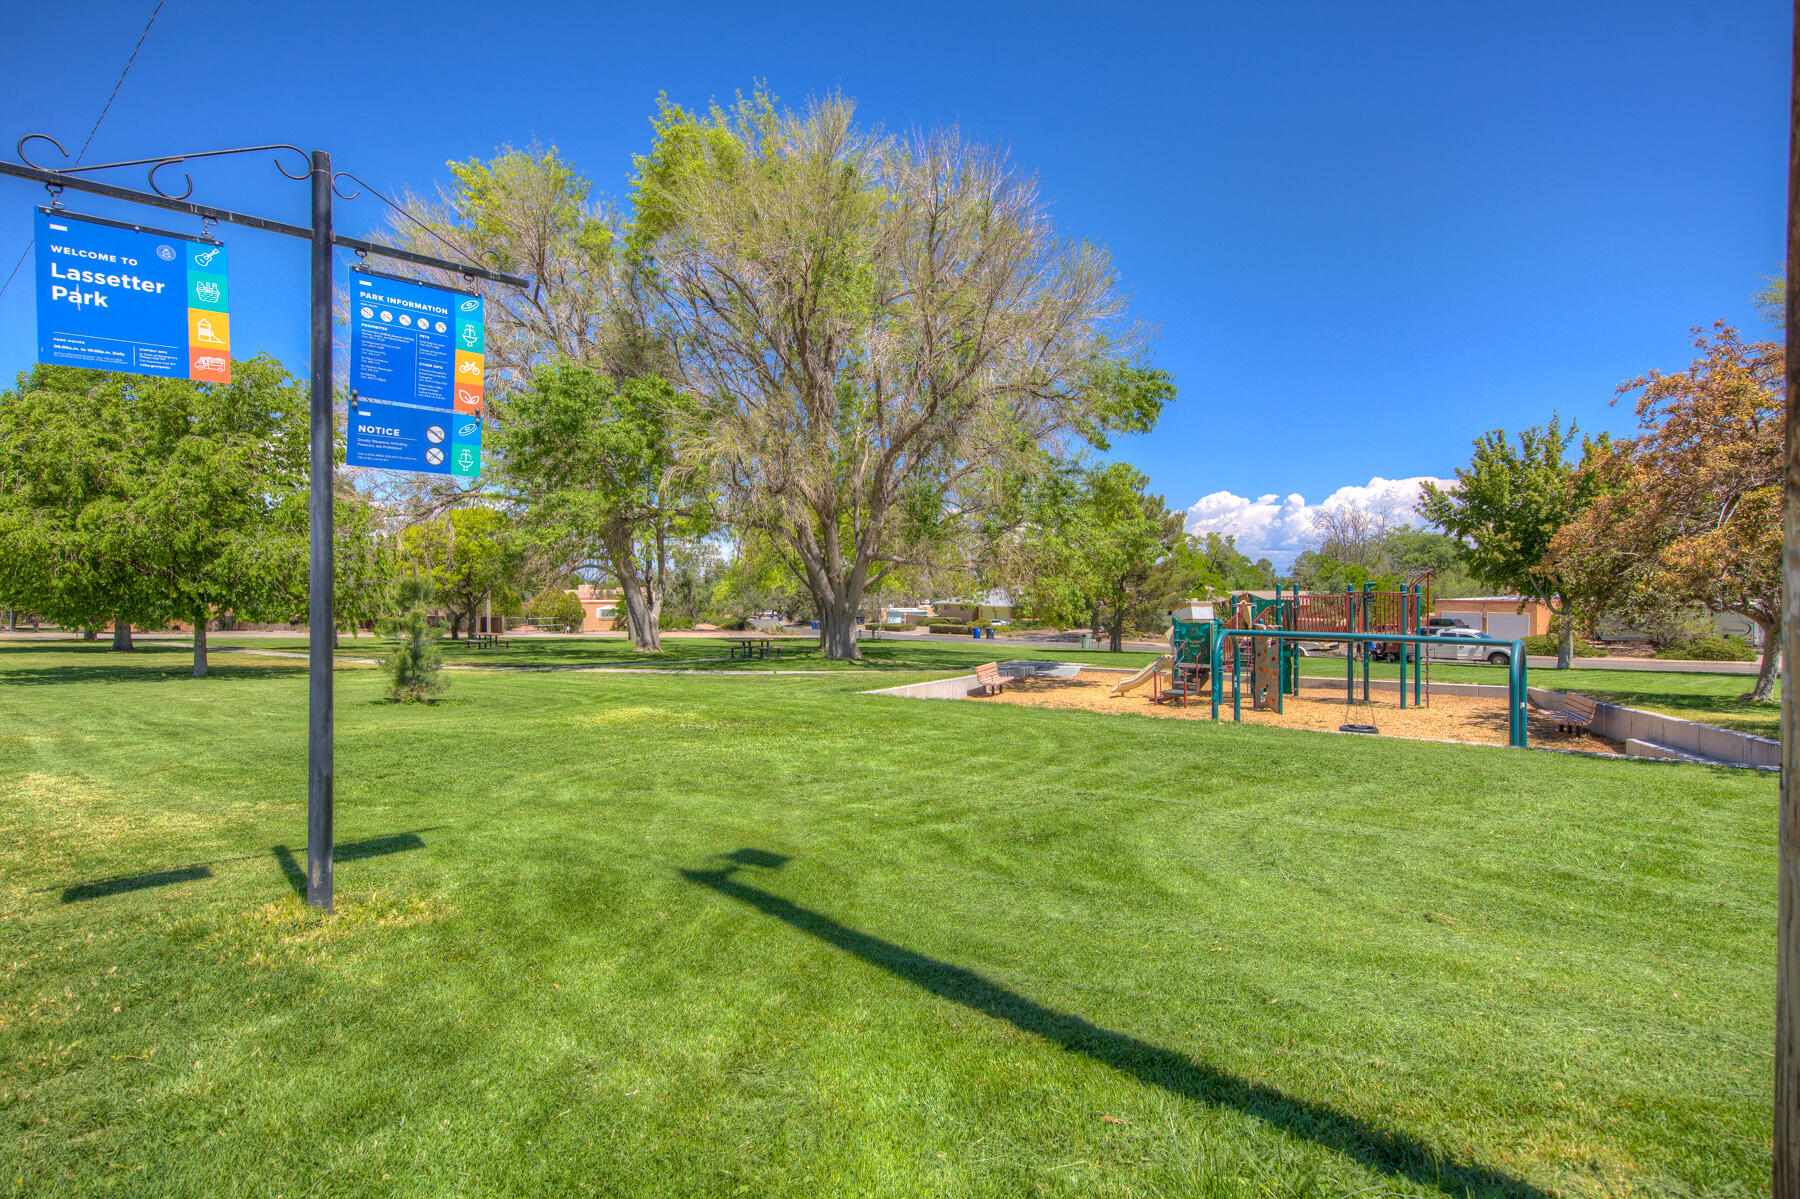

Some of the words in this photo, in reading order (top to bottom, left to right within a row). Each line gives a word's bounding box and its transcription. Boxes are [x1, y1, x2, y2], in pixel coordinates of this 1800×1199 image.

[50, 244, 117, 263] WELCOME
[120, 256, 138, 266] TO
[51, 262, 165, 294] Lassetter
[52, 285, 109, 308] Park
[360, 291, 384, 302] PARK
[387, 296, 448, 315] INFORMATION
[358, 424, 400, 437] NOTICE
